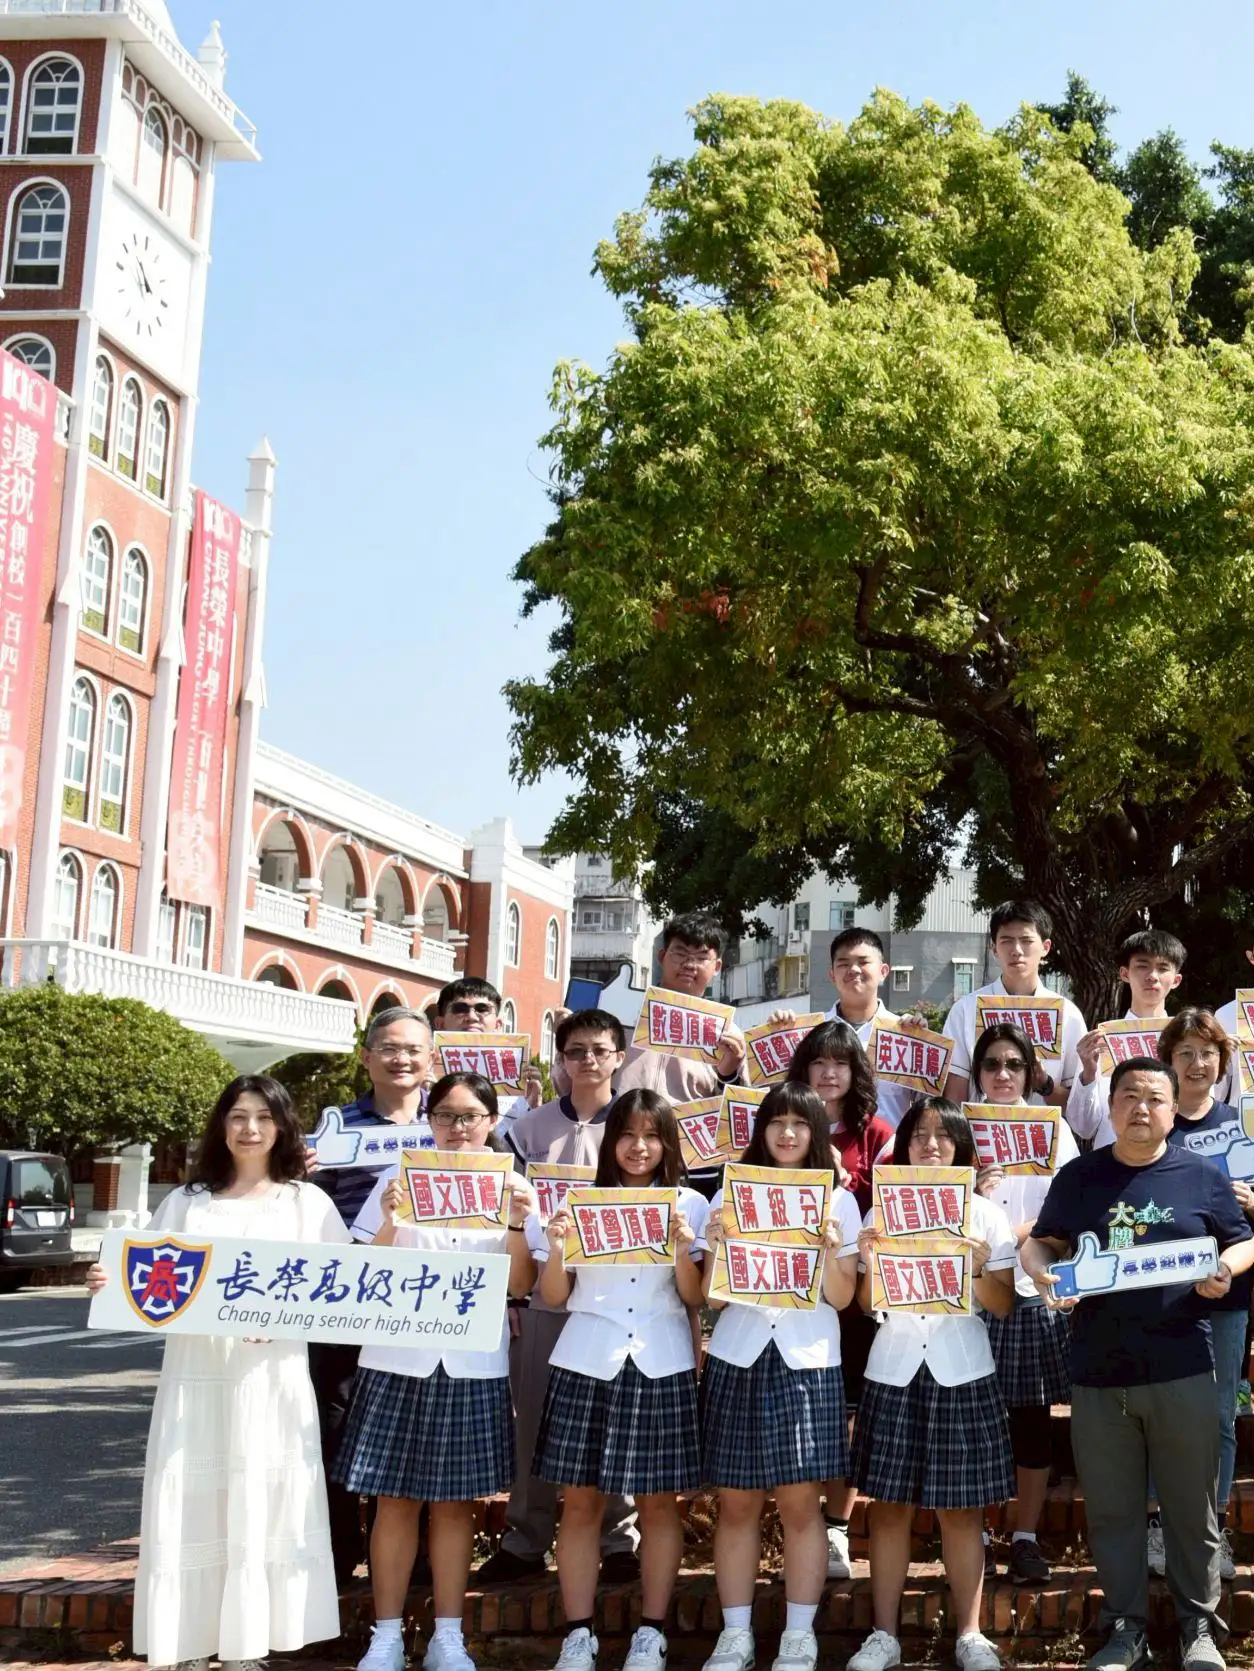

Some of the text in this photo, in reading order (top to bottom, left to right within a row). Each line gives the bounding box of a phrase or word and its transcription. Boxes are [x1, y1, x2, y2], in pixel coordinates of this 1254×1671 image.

[652, 1003, 718, 1048] 數學頂標
[878, 1034, 942, 1077] 英文頂標
[1109, 1034, 1161, 1064] 數學頂
[972, 1124, 1049, 1163] 三科頂標
[1189, 1124, 1241, 1151] Good
[411, 1173, 500, 1218] 國文頂標
[735, 1185, 819, 1229] 滿級分
[882, 1186, 961, 1233] 社會頂標
[578, 1207, 667, 1254] 數學頂標
[216, 1251, 487, 1316] 長榮高級中學
[729, 1244, 811, 1292] 國文頂標
[882, 1258, 961, 1302] 國文頂標
[217, 1304, 471, 1336] Chang Jung senior high school
